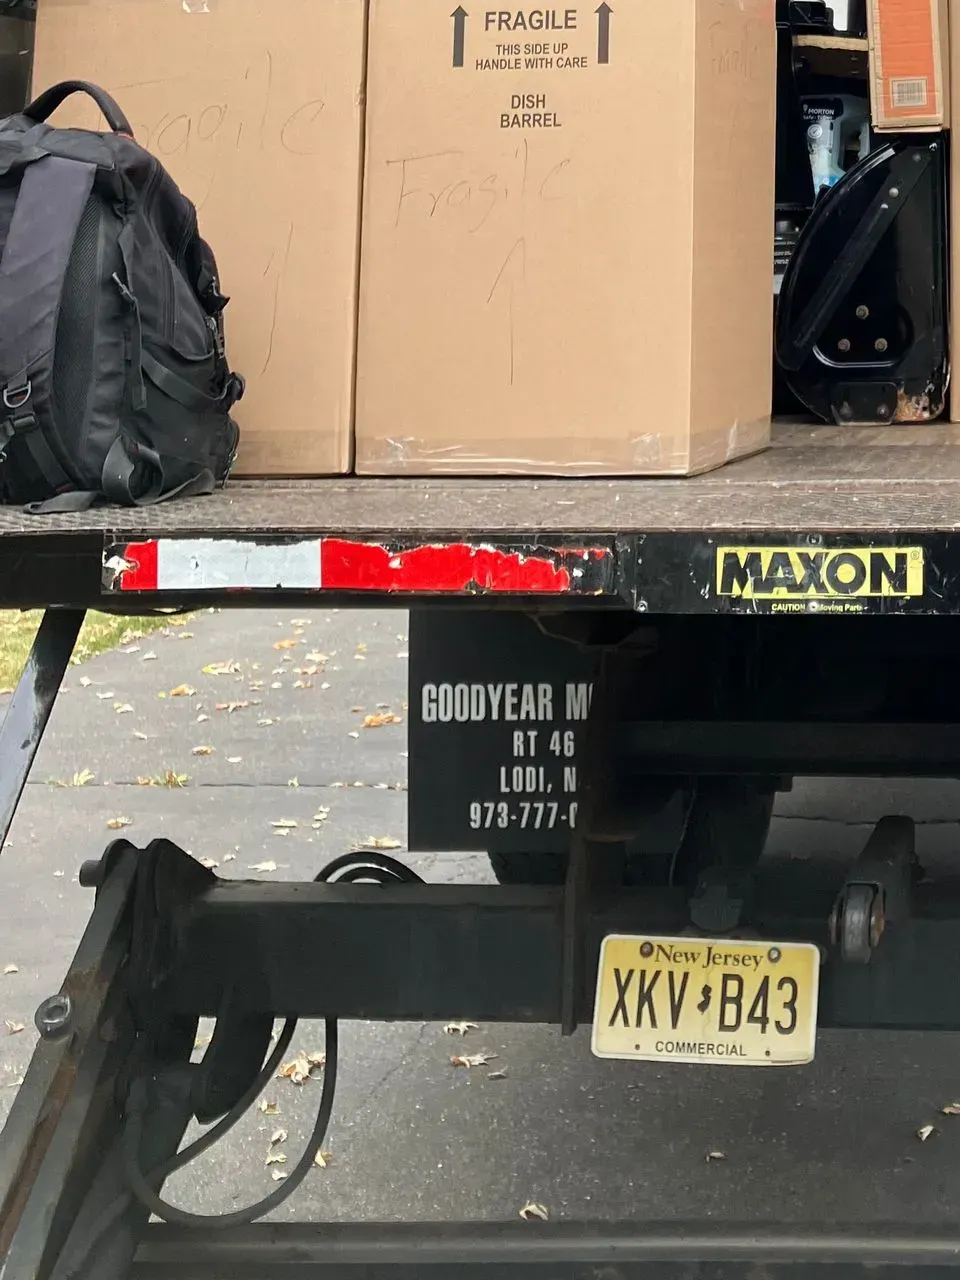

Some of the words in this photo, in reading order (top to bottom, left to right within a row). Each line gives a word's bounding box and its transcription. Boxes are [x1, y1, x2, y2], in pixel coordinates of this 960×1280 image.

[484, 9, 577, 31] FRAGILE
[496, 44, 521, 56] THIS
[523, 43, 550, 55] SIDE
[553, 43, 569, 54] UP
[475, 58, 521, 70] HANDLE
[522, 58, 553, 69] WITH
[556, 56, 588, 68] CARE
[511, 94, 546, 109] DISH
[500, 113, 562, 129] BARREL
[719, 551, 908, 594] MAXON
[771, 603, 805, 612] CAUTION
[421, 683, 553, 722] GOODYEAR
[513, 730, 538, 757] RT
[549, 730, 575, 757] 46
[500, 766, 552, 794] LODI,
[655, 944, 700, 964] New
[702, 946, 764, 972] Jersey
[608, 967, 690, 1030] XKV
[718, 973, 798, 1035] B43
[655, 1040, 747, 1057] COMMERCIAL
